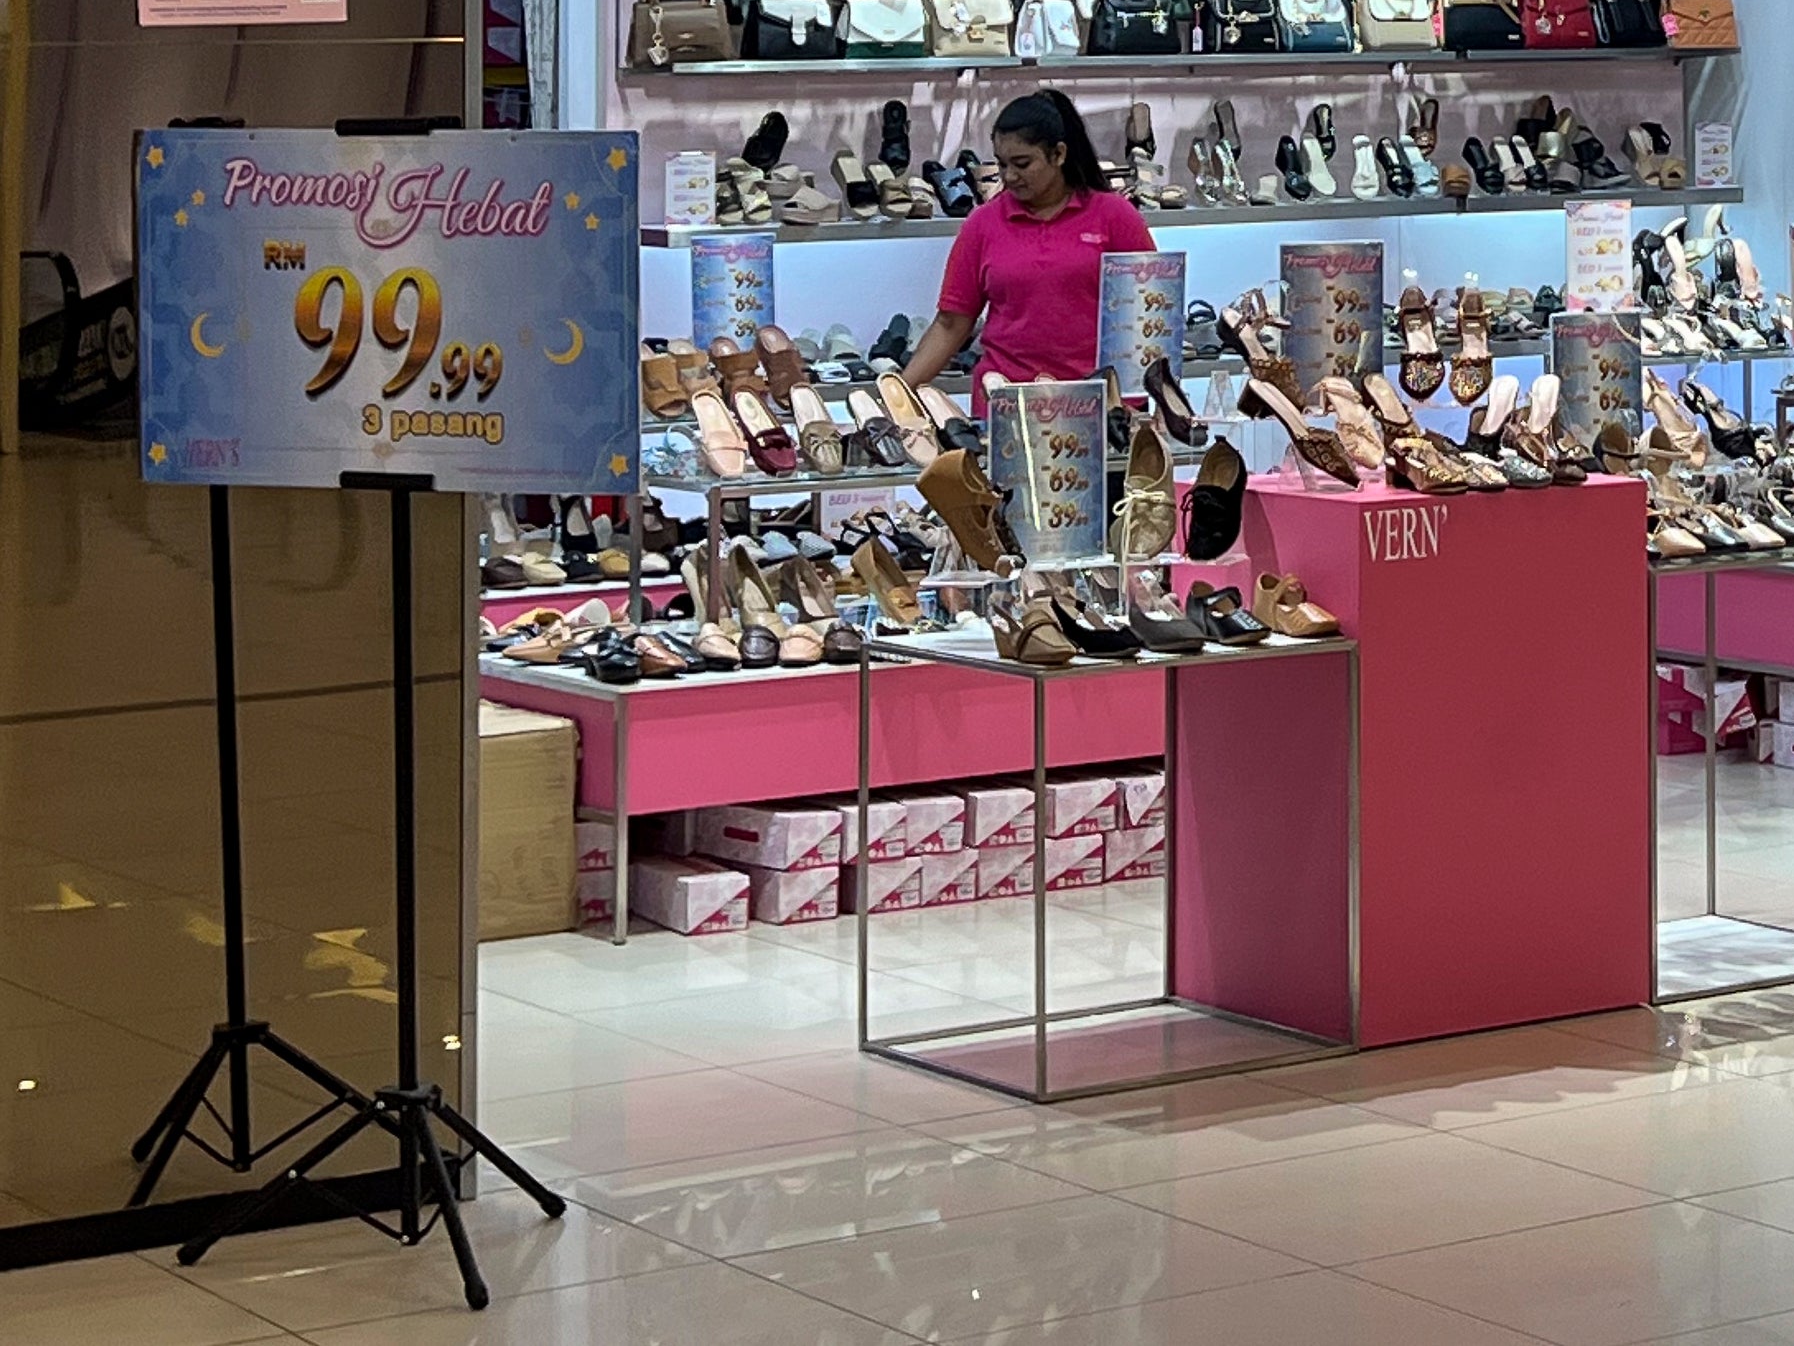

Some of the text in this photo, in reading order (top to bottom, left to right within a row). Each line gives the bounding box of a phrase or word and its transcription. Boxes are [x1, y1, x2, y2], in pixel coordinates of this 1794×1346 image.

[222, 157, 555, 249] Promosi Hebat
[263, 239, 307, 271] RM
[293, 264, 504, 402] 99.99
[362, 403, 504, 445] 3 pasang
[1363, 502, 1449, 563] VERN'
